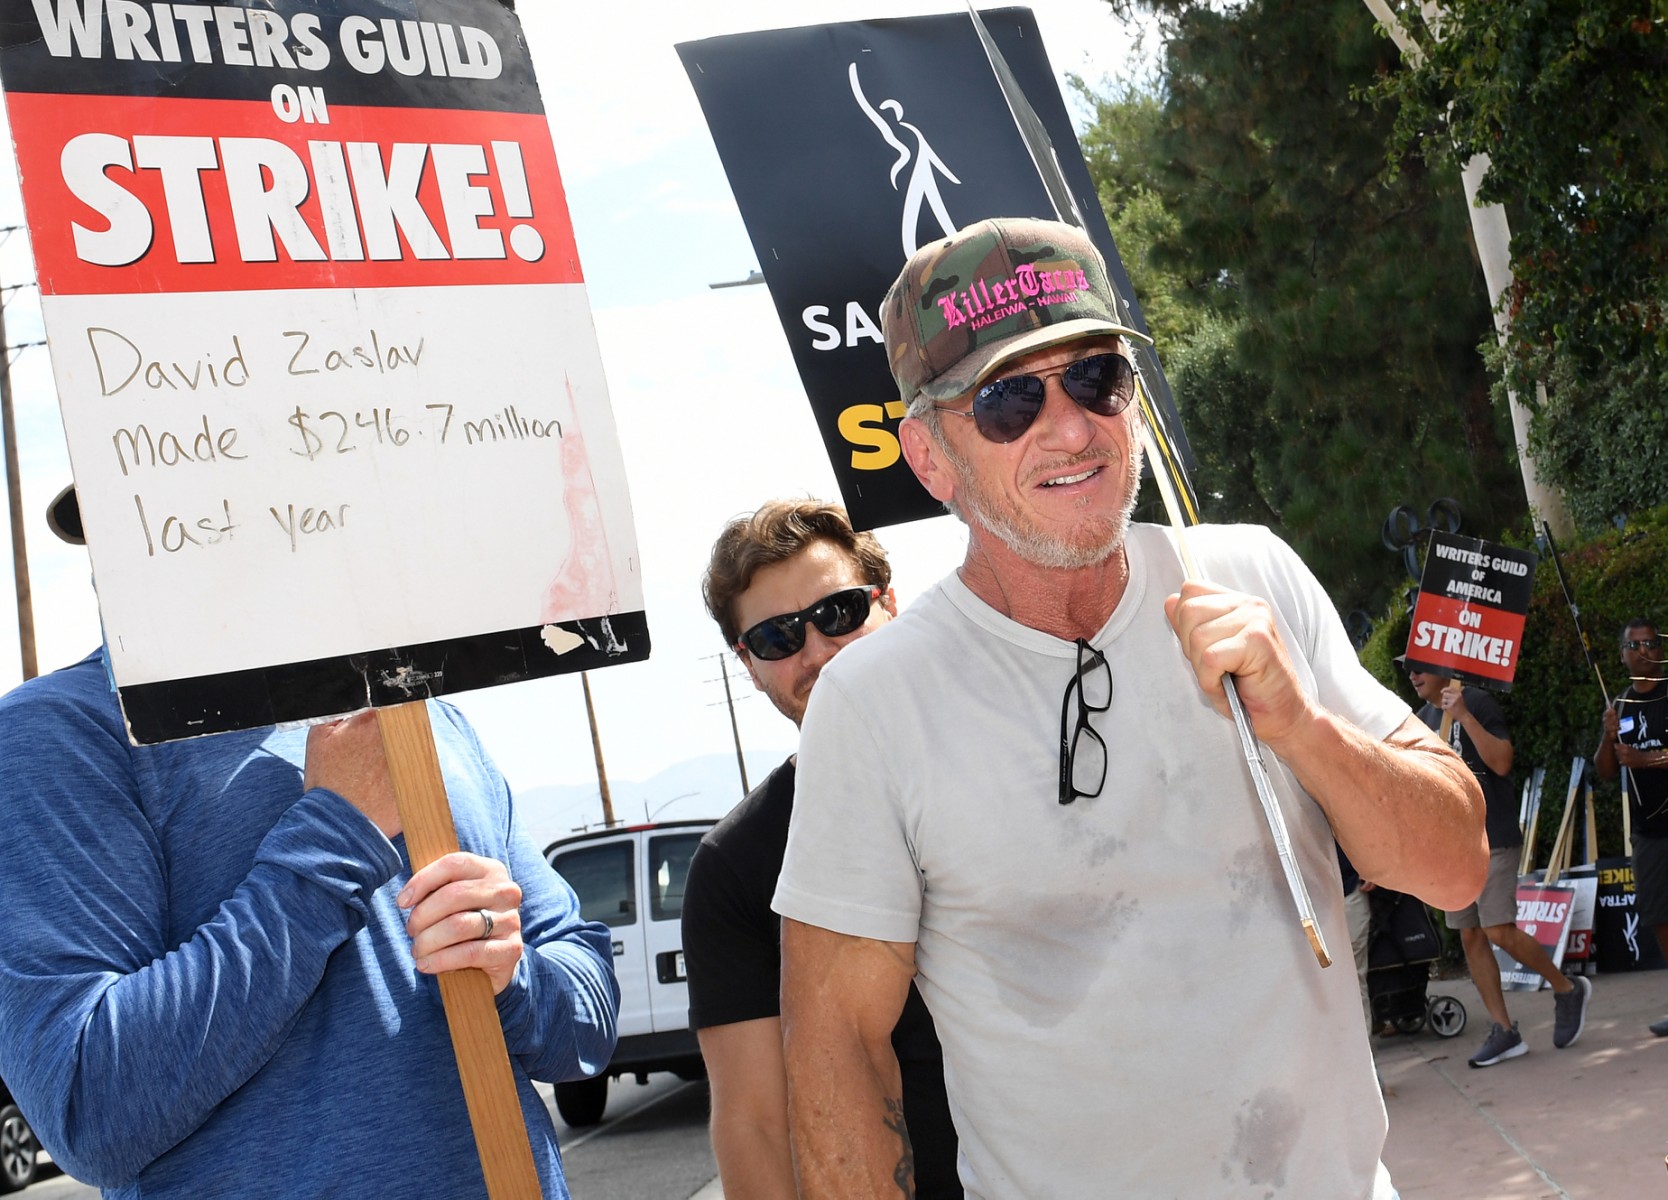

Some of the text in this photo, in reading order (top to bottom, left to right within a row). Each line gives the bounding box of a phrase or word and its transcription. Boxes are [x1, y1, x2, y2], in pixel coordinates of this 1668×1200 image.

[30, 0, 503, 80] WRITERS GUILD
[271, 84, 330, 125] ON
[60, 133, 546, 268] STRIKE!
[802, 301, 885, 350] SA
[971, 301, 1027, 331] HALEIWA
[1036, 292, 1078, 307] HAWAII
[88, 327, 425, 398] David Zaslav
[464, 405, 563, 445] million
[134, 494, 351, 556] last year
[1436, 543, 1528, 577] WRITERS GUILD
[1471, 569, 1486, 582] OF
[1446, 579, 1502, 604] AMERICA
[1458, 609, 1482, 629] ON
[1414, 620, 1513, 667] STRIKE!
[1516, 900, 1567, 924] STRIKE
[1599, 893, 1636, 908] AFTRA
